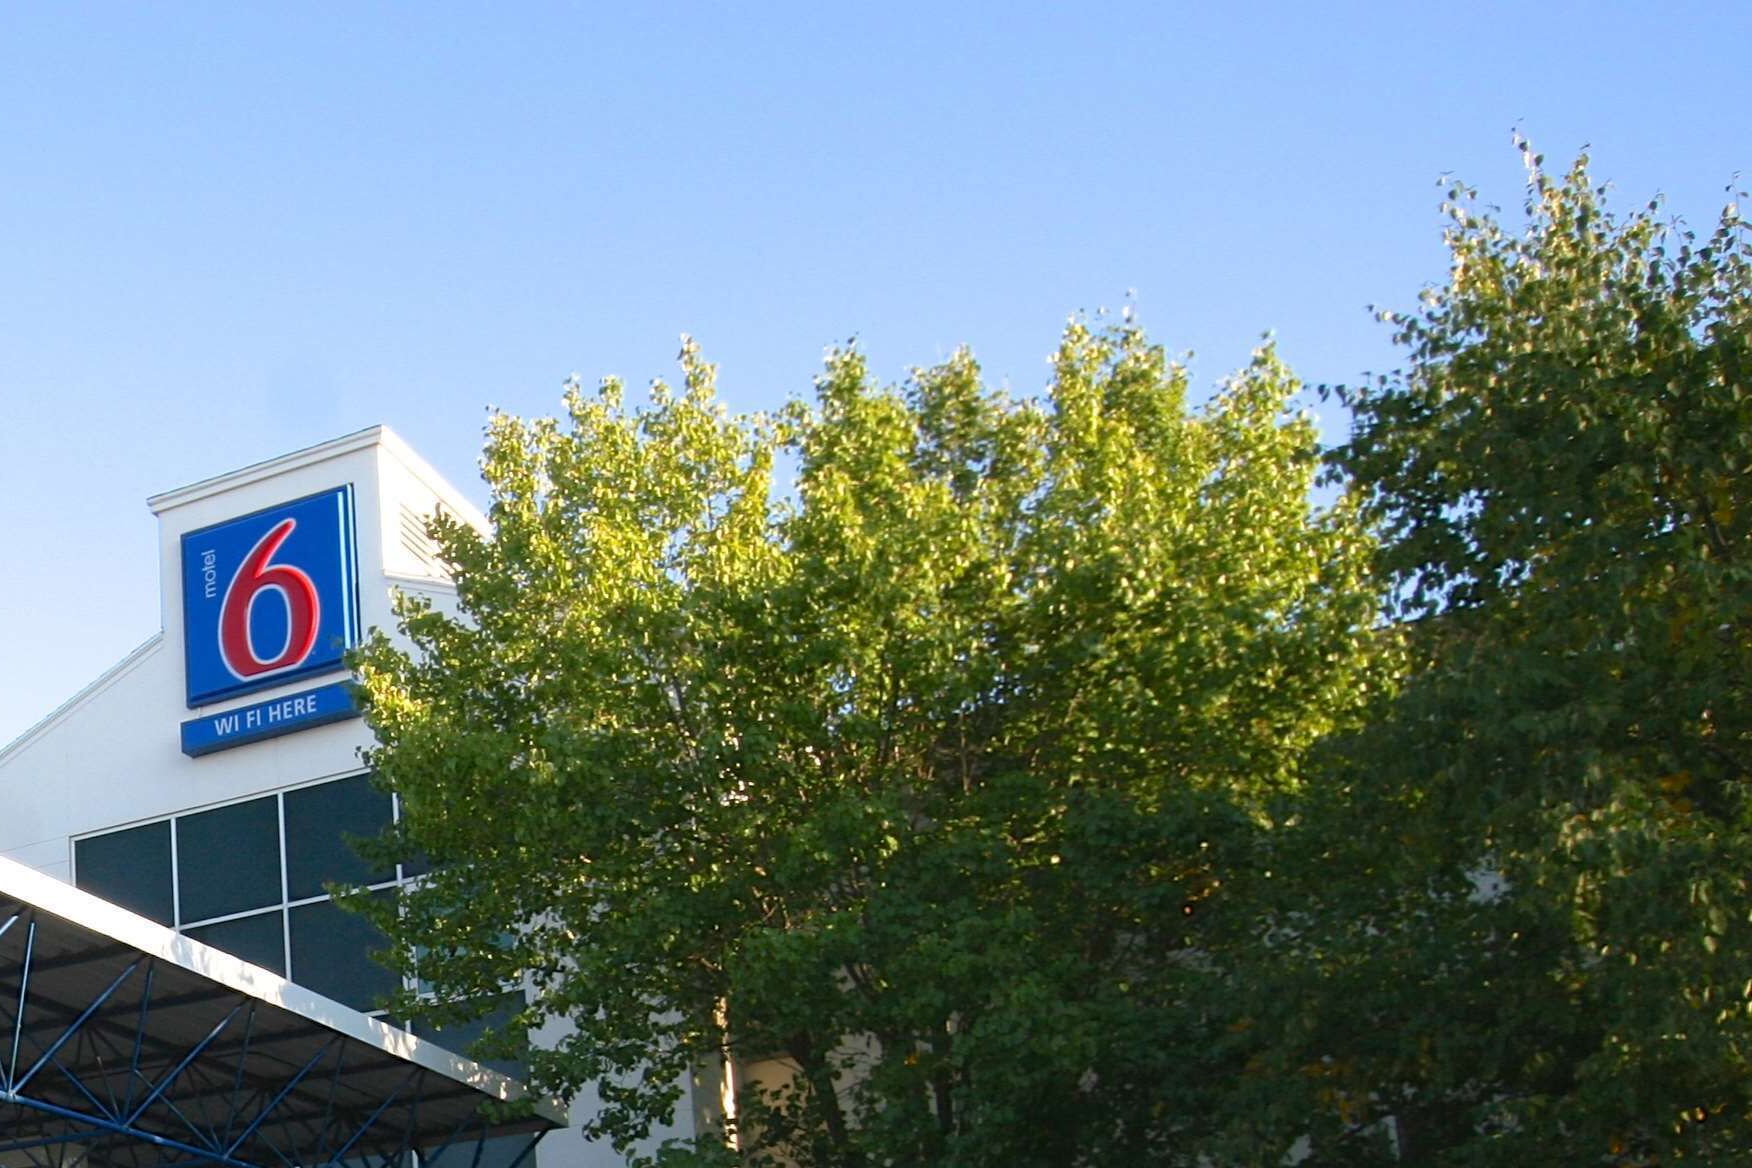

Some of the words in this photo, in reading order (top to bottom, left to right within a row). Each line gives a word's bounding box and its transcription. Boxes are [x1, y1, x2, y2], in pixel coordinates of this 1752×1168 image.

[201, 549, 217, 599] motel
[218, 517, 321, 682] 6
[214, 714, 240, 737] WI
[246, 709, 262, 729] FI
[268, 695, 317, 723] HERE
